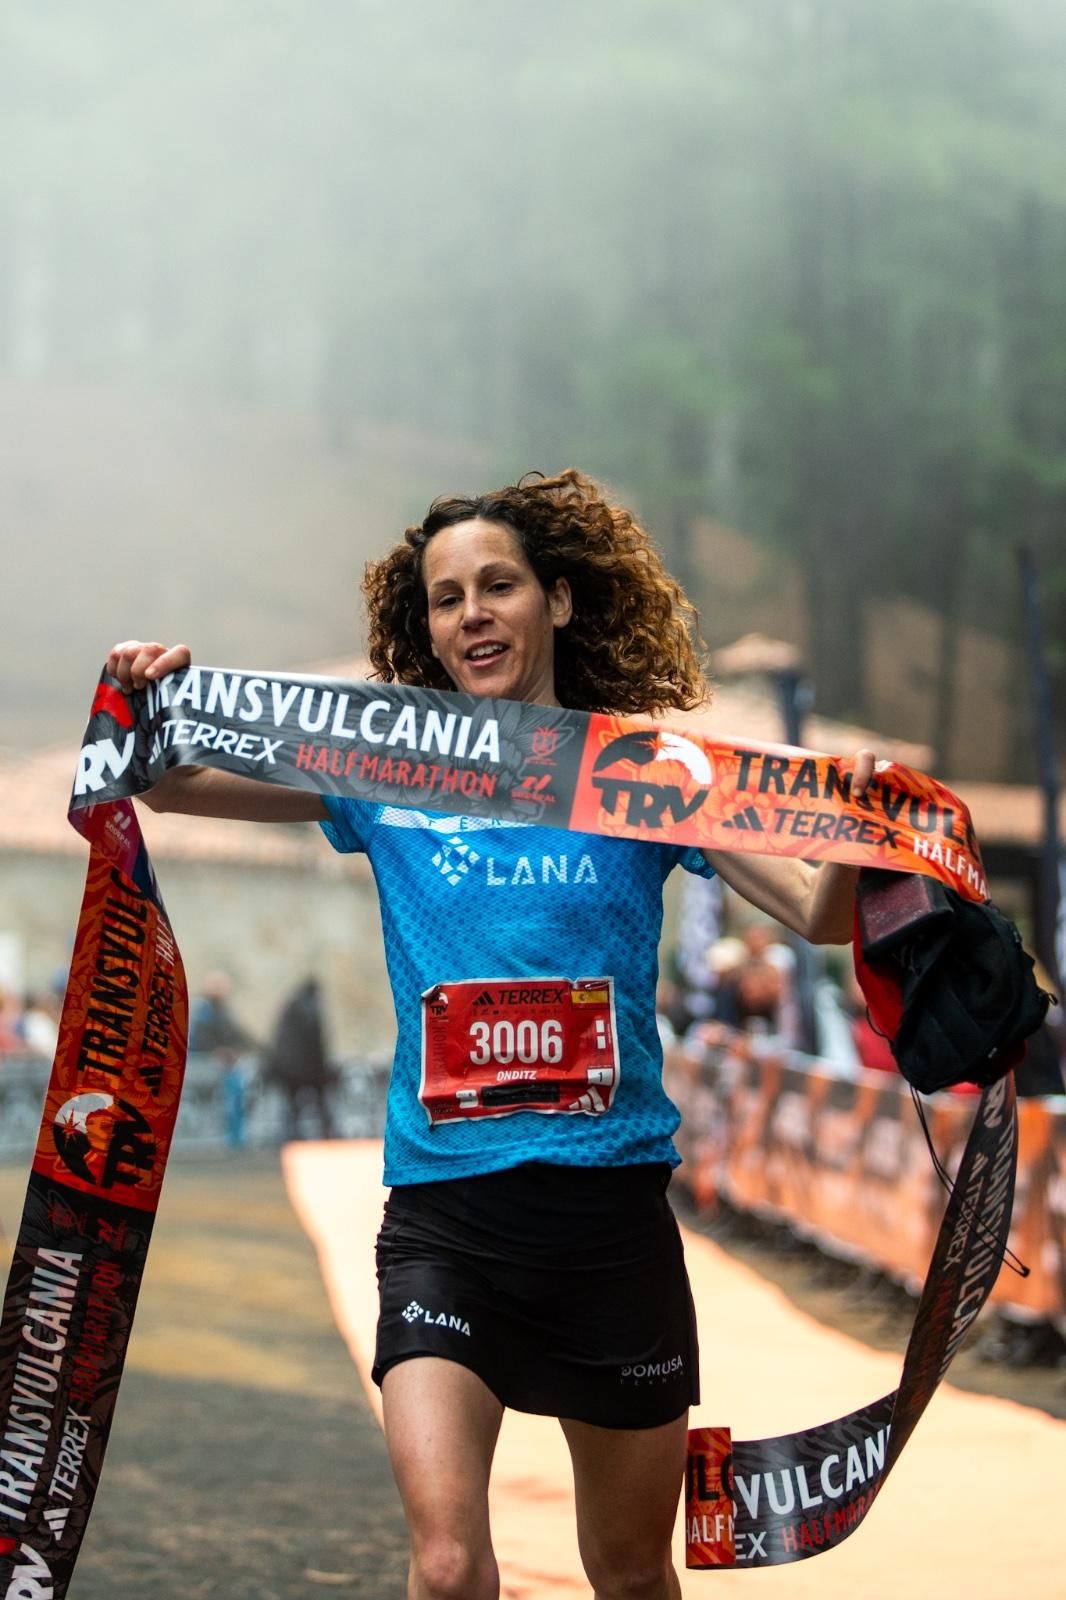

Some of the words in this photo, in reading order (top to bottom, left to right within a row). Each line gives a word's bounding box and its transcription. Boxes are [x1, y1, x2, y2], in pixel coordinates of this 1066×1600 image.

[162, 719, 284, 765] TERREX
[486, 854, 598, 887] LANA
[774, 808, 902, 849] TERREX
[913, 836, 991, 901] HALFMA
[140, 963, 176, 1057] TERREX
[497, 988, 567, 1005] TERREX
[469, 1019, 563, 1066] 3006
[496, 1070, 537, 1081] ONDITZ
[424, 1310, 471, 1336] LANA
[620, 1354, 684, 1377] DOMUSA
[48, 1405, 92, 1501] TERREX
